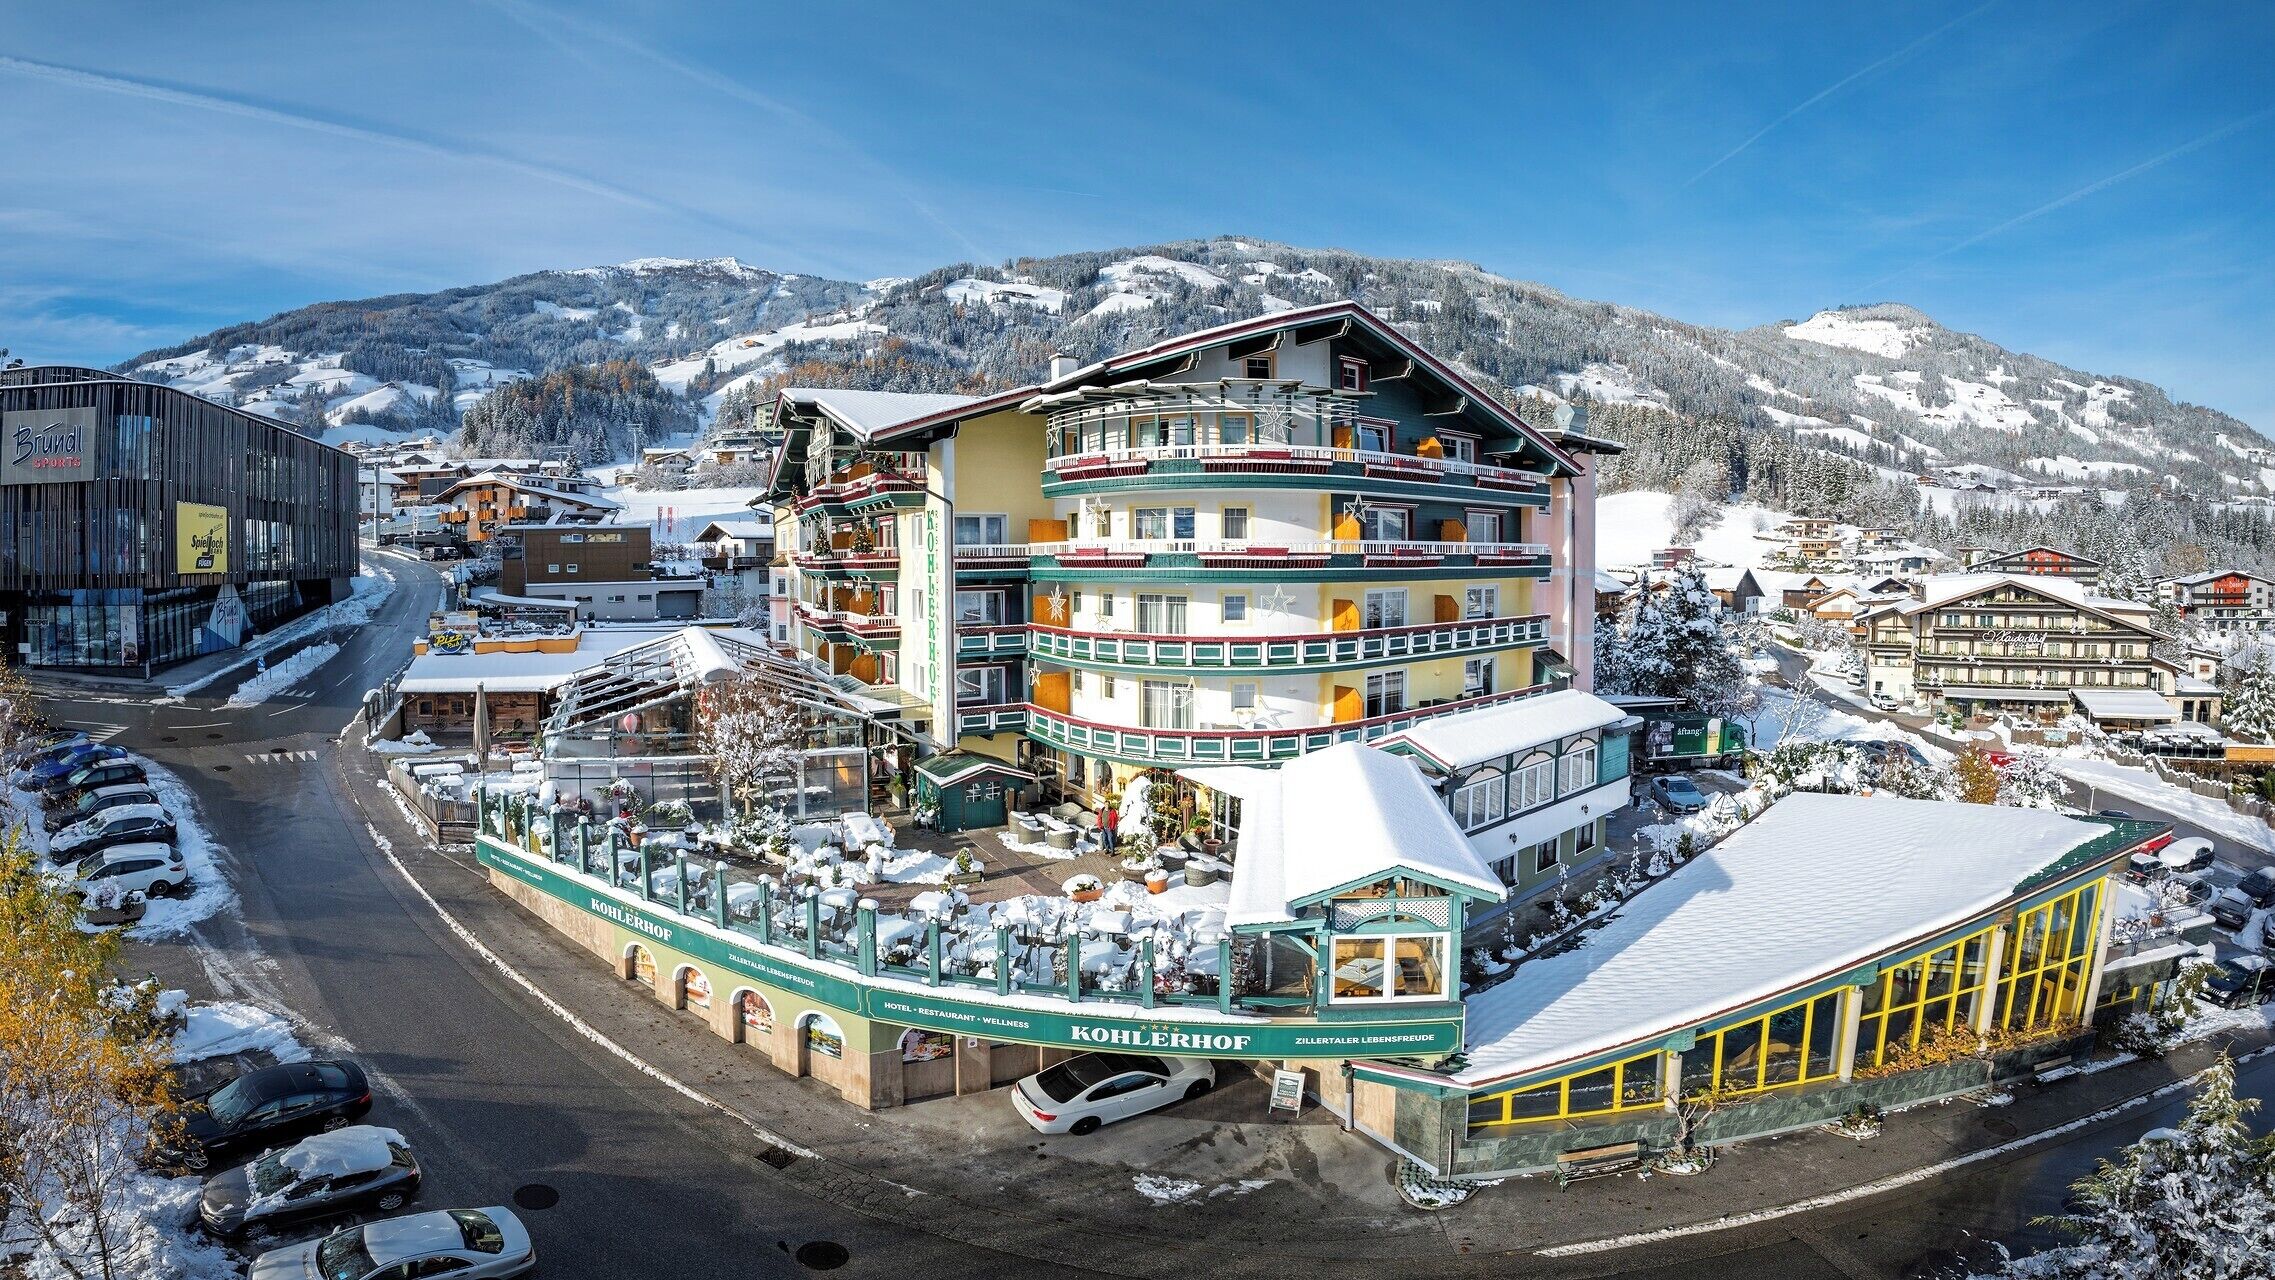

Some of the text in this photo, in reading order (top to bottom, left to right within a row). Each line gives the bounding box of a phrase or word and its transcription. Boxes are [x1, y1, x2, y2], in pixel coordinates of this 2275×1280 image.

[32, 456, 82, 469] SPORTS
[191, 532, 224, 554] Spieljoch
[927, 510, 936, 705] KOHLERHOF
[591, 897, 673, 941] KOHLERHOF
[728, 953, 815, 988] ZILLERTALER LEBENSFREUDE
[884, 1001, 1030, 1029] HOTEL RESTAURANT WELLNESS
[1071, 1025, 1251, 1050] KOHLERHOF
[1295, 1034, 1435, 1045] ZILLERTALER LEBENSFREUDE
